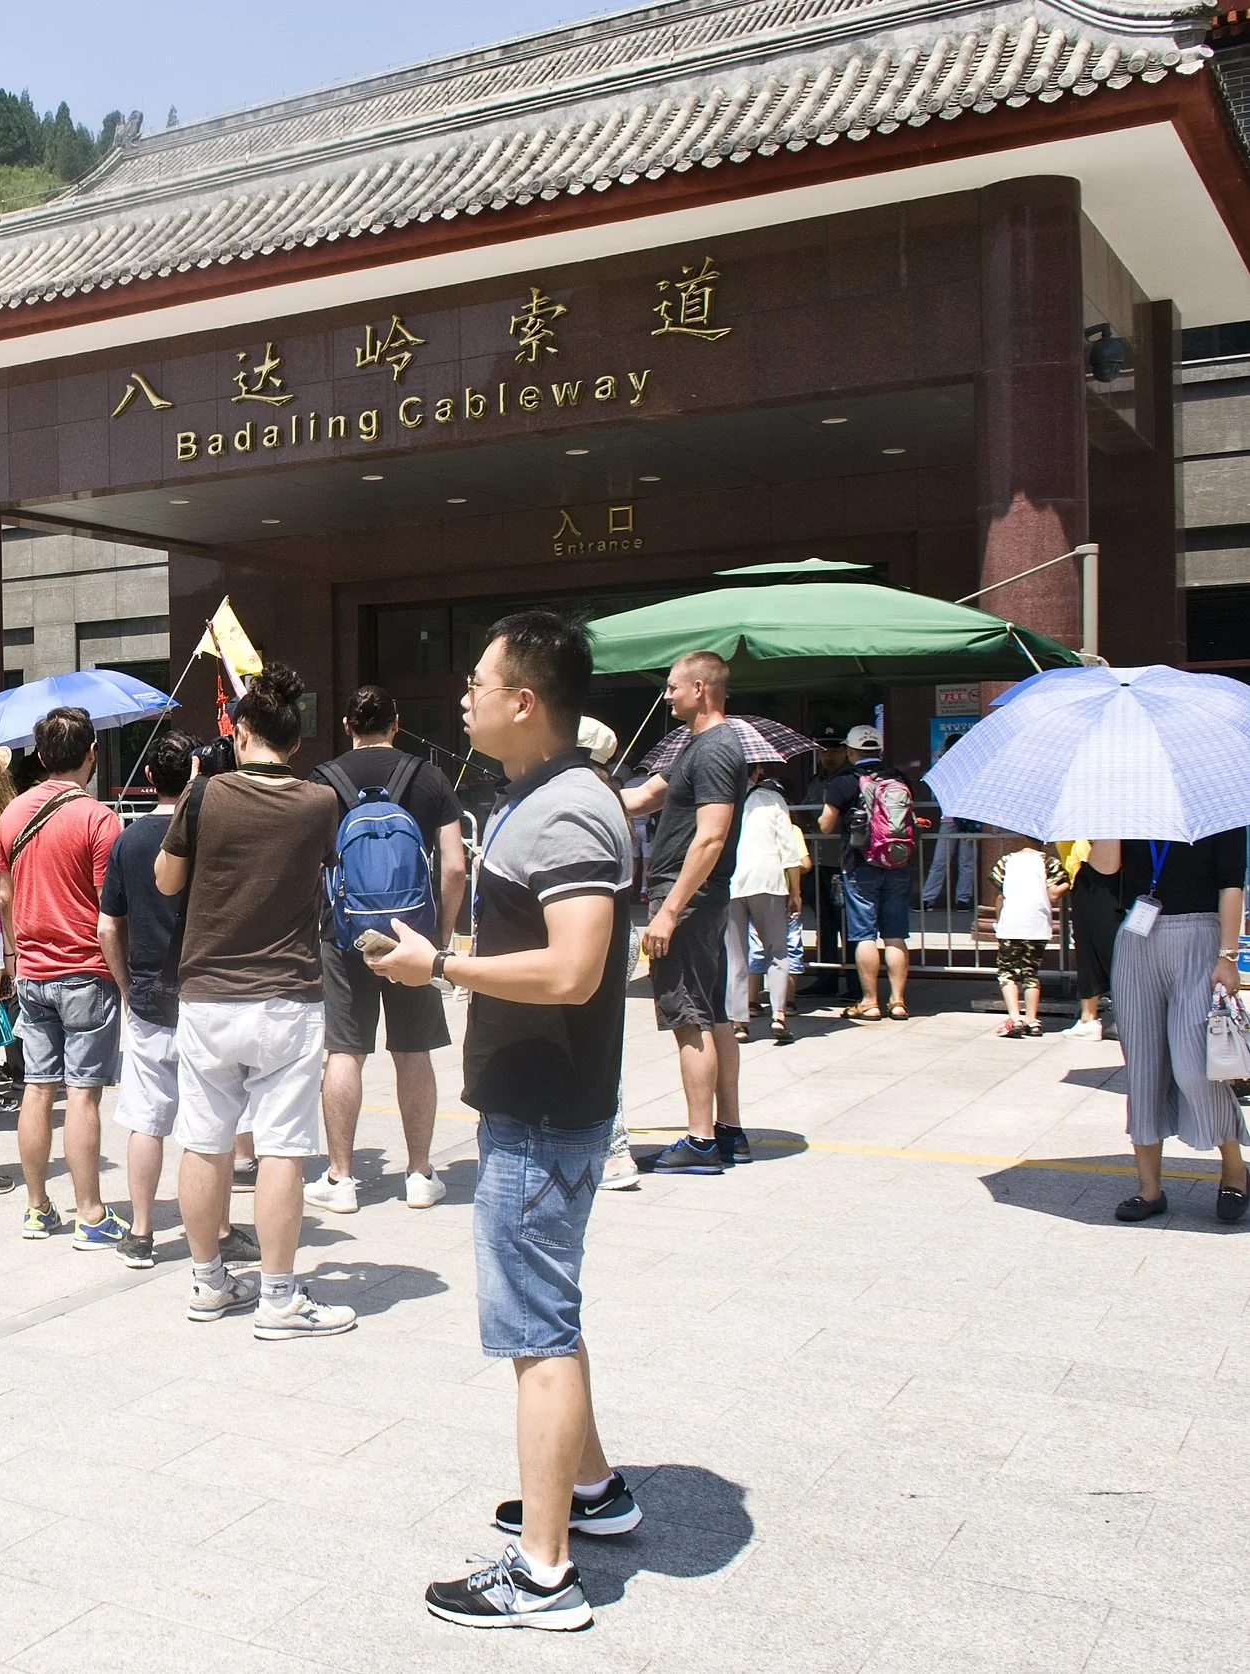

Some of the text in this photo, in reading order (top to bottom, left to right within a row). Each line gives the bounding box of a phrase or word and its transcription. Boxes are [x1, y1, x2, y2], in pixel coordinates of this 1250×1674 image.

[112, 257, 731, 417] 八达岭索道
[176, 368, 653, 462] Badaling Cableway
[552, 504, 634, 540] 入口
[553, 538, 644, 557] Entrance
